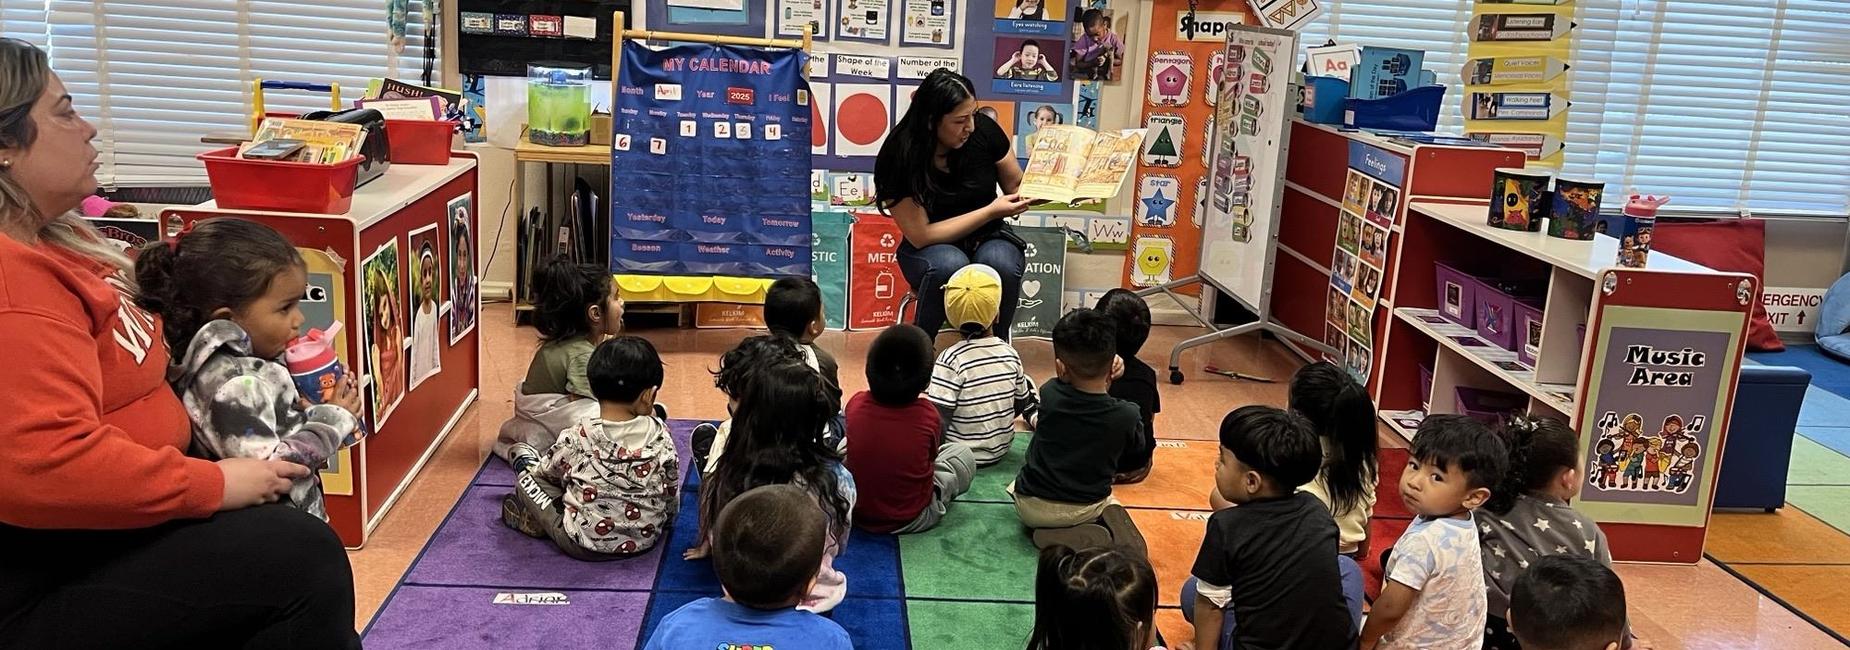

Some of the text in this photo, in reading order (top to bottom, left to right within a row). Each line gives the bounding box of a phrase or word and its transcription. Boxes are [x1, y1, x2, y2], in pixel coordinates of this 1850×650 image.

[1180, 15, 1230, 36] Shap
[663, 57, 772, 75] MY CALENDAR
[838, 56, 887, 67] Shape of the
[900, 58, 956, 67] Number of the
[1326, 58, 1348, 72] Aa
[851, 68, 873, 77] Week
[387, 83, 424, 97] HUSH!
[697, 90, 715, 98] Year
[730, 92, 750, 101] 2025
[1151, 117, 1183, 125] triangle
[686, 125, 691, 134] 1
[718, 124, 728, 135] 2
[769, 126, 776, 136] 4
[620, 137, 627, 148] 6
[653, 140, 662, 150] 7
[1365, 153, 1386, 175] Feelings
[840, 181, 858, 196] Ee
[1150, 179, 1171, 187] star
[627, 212, 800, 228] Yesterday Today Tomorrow
[1094, 223, 1124, 238] Ww
[697, 245, 731, 255] Weather
[766, 249, 795, 260] Activity
[812, 251, 837, 262] STIC
[867, 252, 898, 264] META
[1024, 263, 1061, 275] ATION
[1762, 294, 1823, 307] ERGENC
[1768, 312, 1789, 325] XIT
[1624, 345, 1705, 366] Music
[1628, 367, 1693, 386] Area
